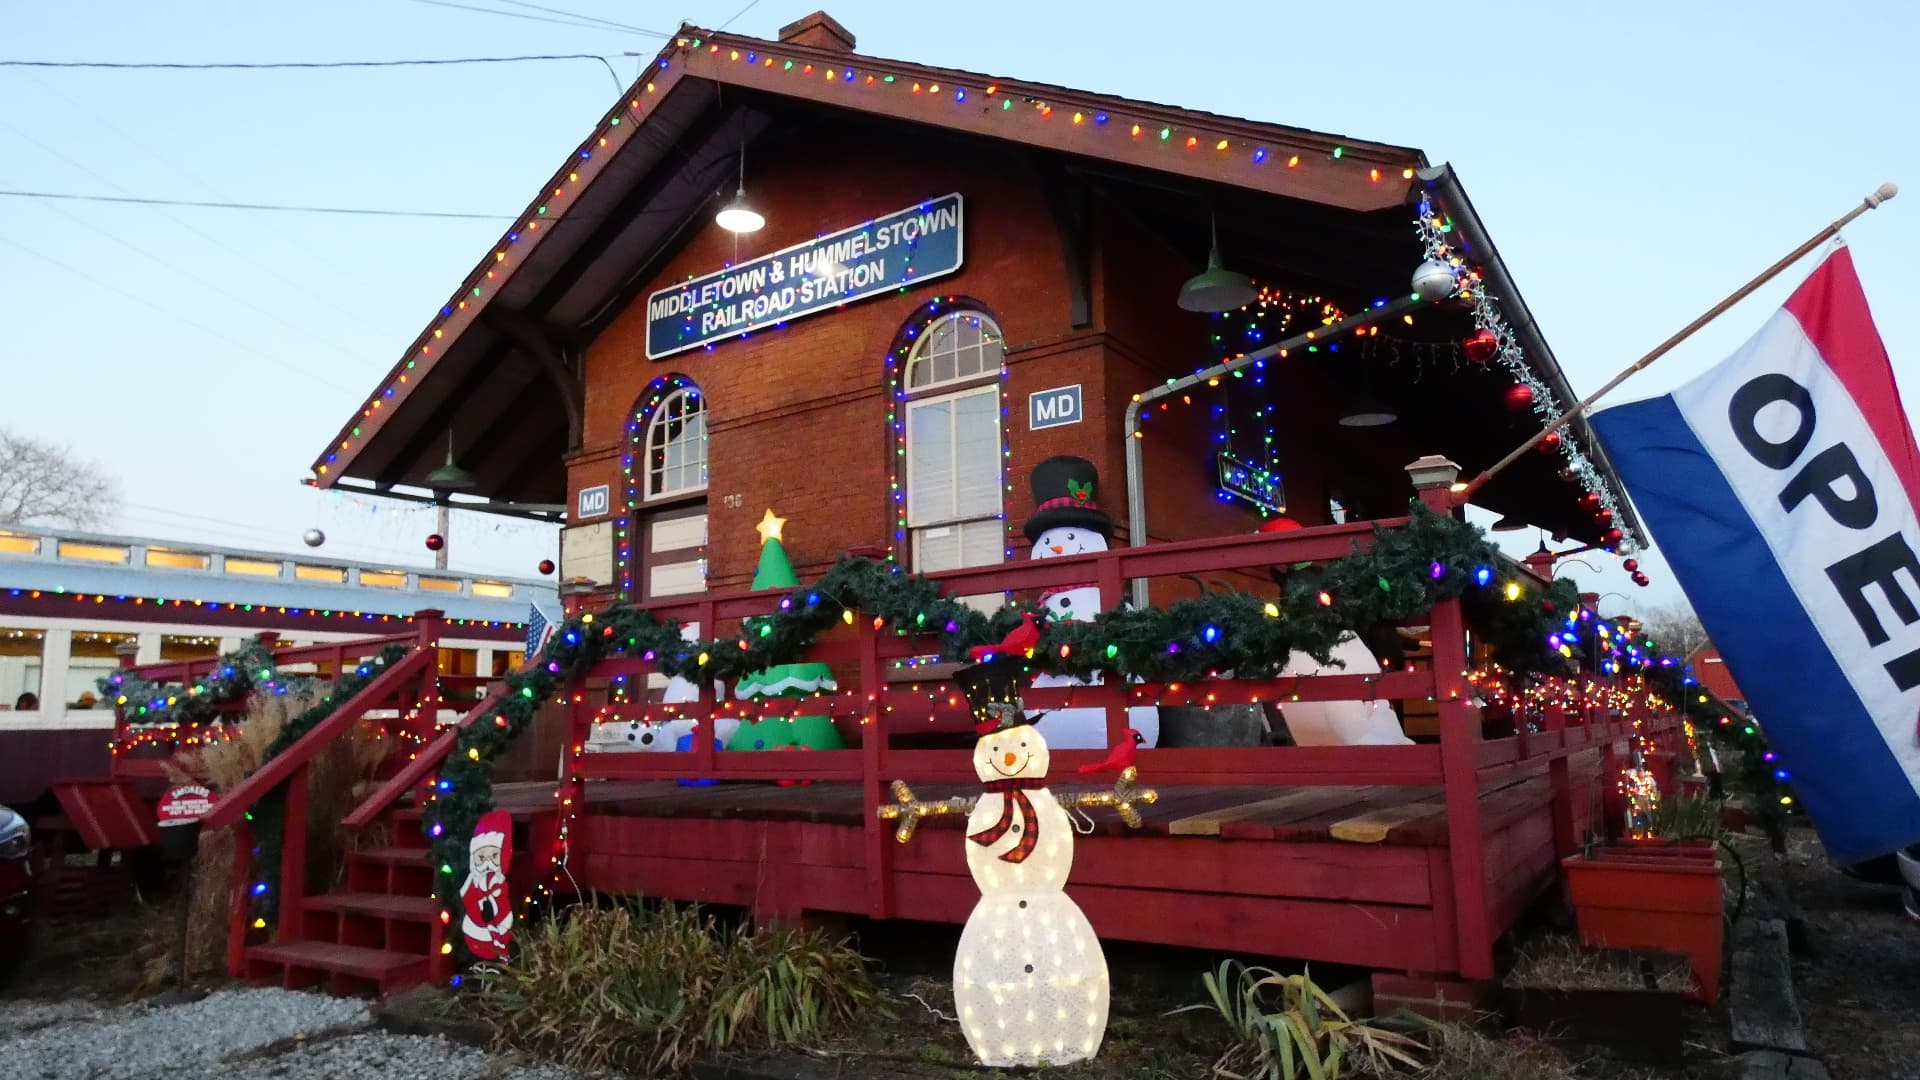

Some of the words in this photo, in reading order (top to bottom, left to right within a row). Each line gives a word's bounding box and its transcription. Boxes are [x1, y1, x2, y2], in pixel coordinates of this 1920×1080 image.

[651, 266, 766, 321] MIDDLETOWN
[771, 262, 785, 284] &
[790, 205, 956, 277] HUMMELSTOWN
[702, 287, 796, 333] RAILROAD
[800, 258, 885, 304] STATION
[1037, 394, 1074, 422] MD
[583, 491, 605, 513] MD
